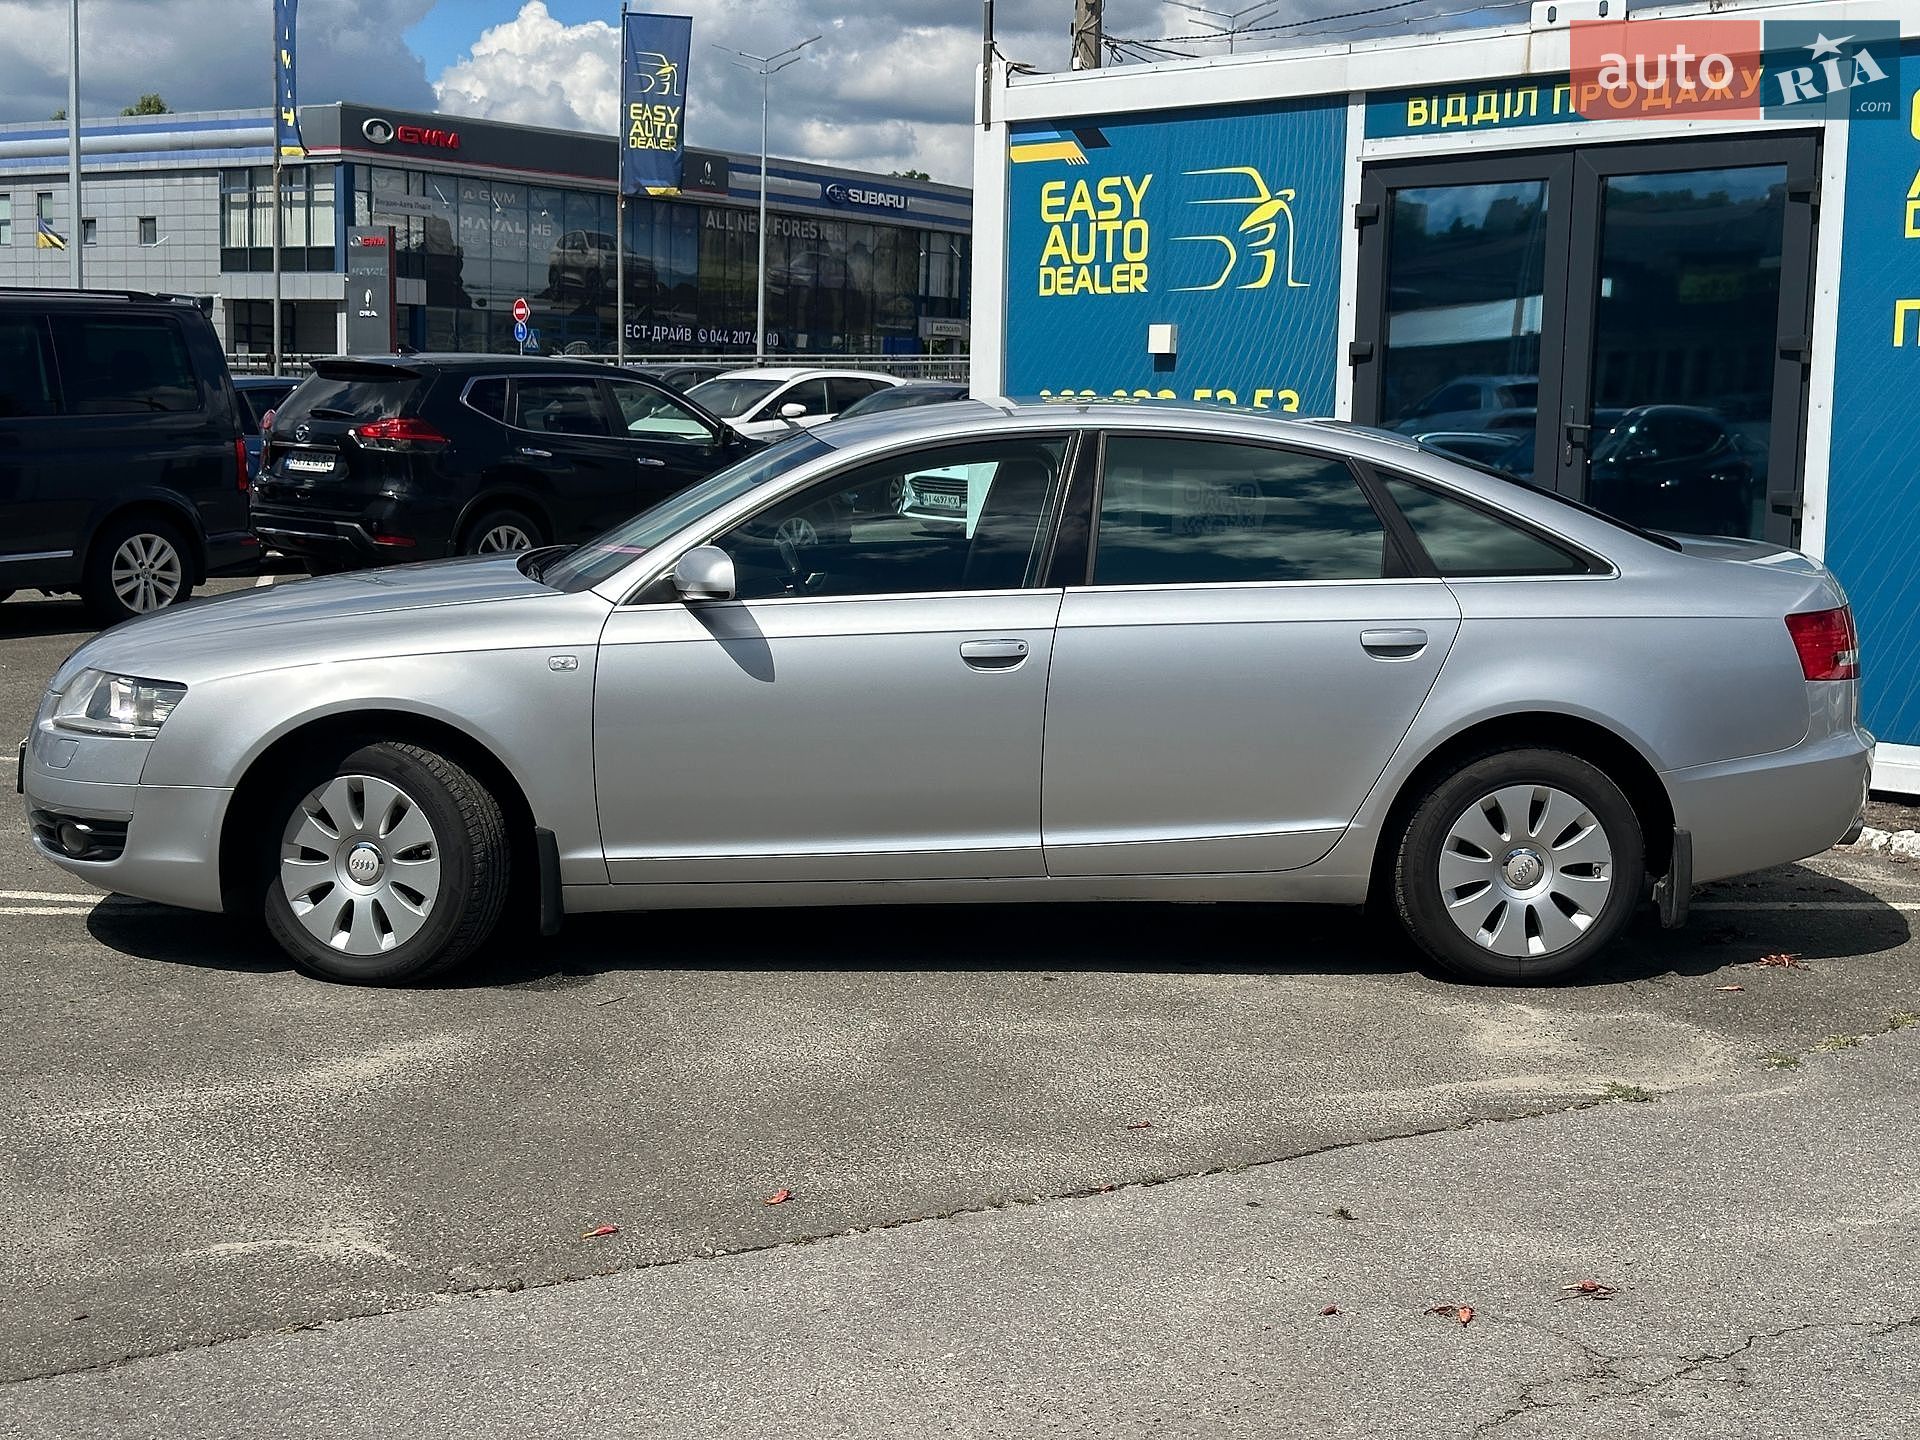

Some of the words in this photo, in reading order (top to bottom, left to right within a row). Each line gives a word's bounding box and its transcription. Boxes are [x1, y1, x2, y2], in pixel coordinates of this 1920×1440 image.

[630, 103, 680, 123] EASY
[1407, 87, 1538, 128] ВІДДІЛ
[397, 126, 460, 149] GWM
[630, 121, 678, 139] AUTO
[629, 137, 677, 152] DEALER
[479, 190, 517, 204] GWM
[848, 188, 905, 209] SUBARU
[1041, 174, 1153, 223] EASY
[460, 216, 526, 235] HAVAL
[706, 210, 734, 231] ALL
[737, 214, 768, 234] NE
[774, 218, 842, 241] FORESTER
[1040, 219, 1149, 265] AUTO
[1039, 263, 1148, 297] DEALER
[625, 323, 692, 342] ЕСТ-ДРАЙВ
[710, 329, 729, 343] 044
